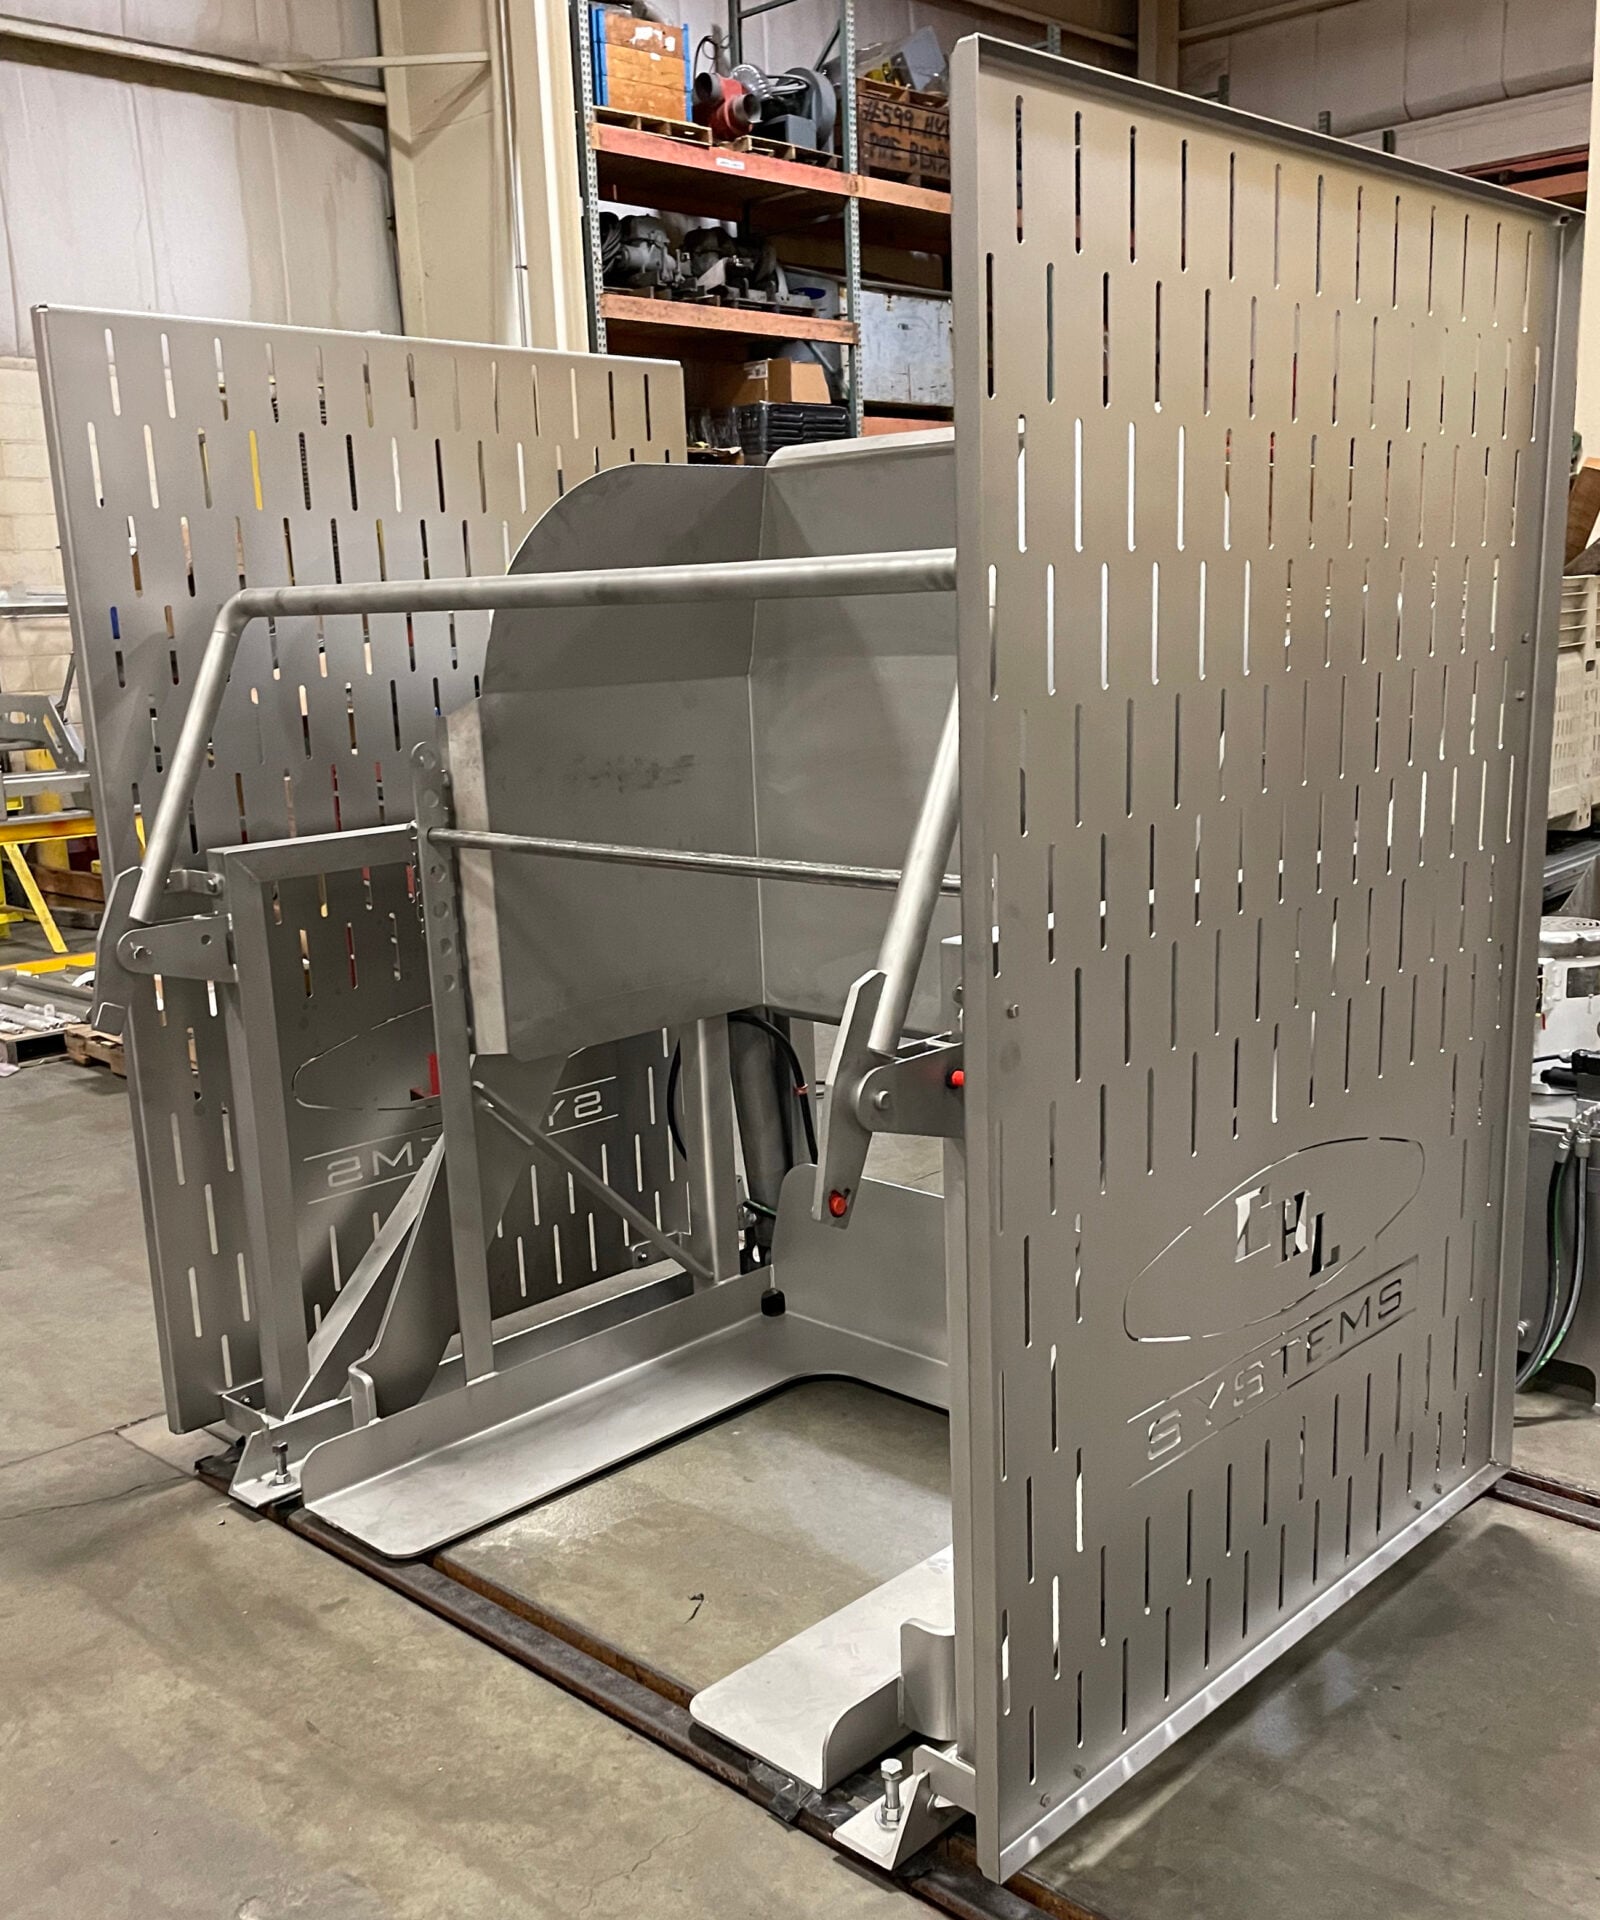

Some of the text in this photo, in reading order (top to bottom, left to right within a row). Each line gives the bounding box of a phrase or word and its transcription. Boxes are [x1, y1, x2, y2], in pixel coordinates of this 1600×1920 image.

[862, 101, 914, 136] #599
[909, 141, 951, 175] BEND
[1234, 1184, 1341, 1278] CHL
[1147, 1278, 1403, 1461] SYSTEMS
